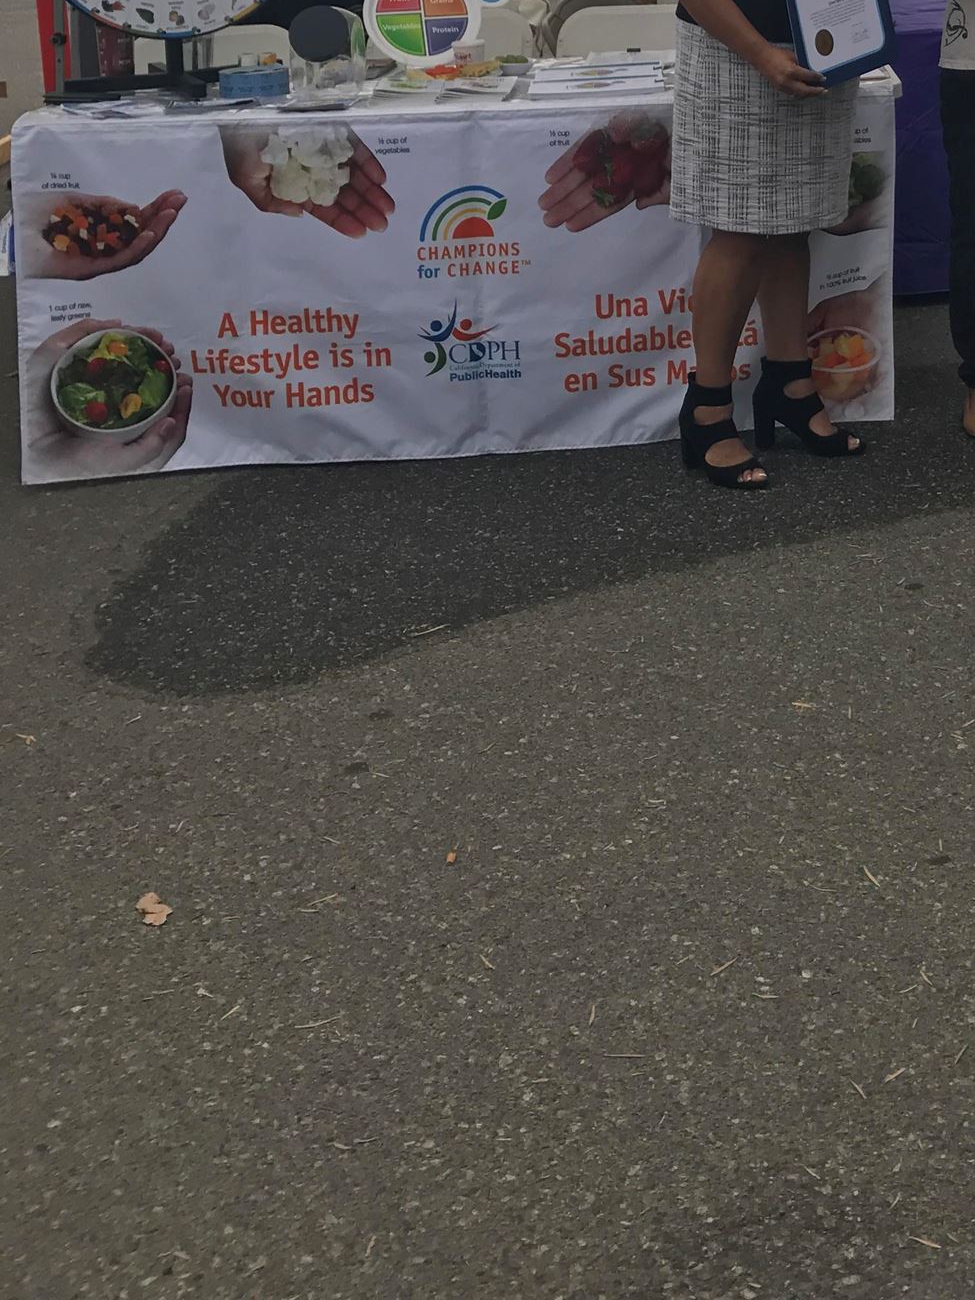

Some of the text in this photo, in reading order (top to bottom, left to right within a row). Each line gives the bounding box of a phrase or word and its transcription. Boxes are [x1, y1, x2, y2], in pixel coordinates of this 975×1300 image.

[381, 23, 422, 31] Vegetables
[431, 26, 460, 34] Protein
[400, 136, 407, 144] of
[375, 147, 410, 155] vegetables
[417, 242, 521, 261] CHAMPIONS
[417, 264, 441, 279] for
[69, 302, 76, 310] of
[595, 287, 693, 319] Una Vi
[51, 311, 91, 322] leafy greens
[218, 307, 359, 339] A Healthy
[554, 324, 692, 358] Saludable
[190, 341, 392, 379] Lifestyle is in
[449, 340, 520, 364] CDPH
[564, 371, 598, 393] en
[608, 364, 656, 388] Sus
[212, 377, 375, 409] Your Hands
